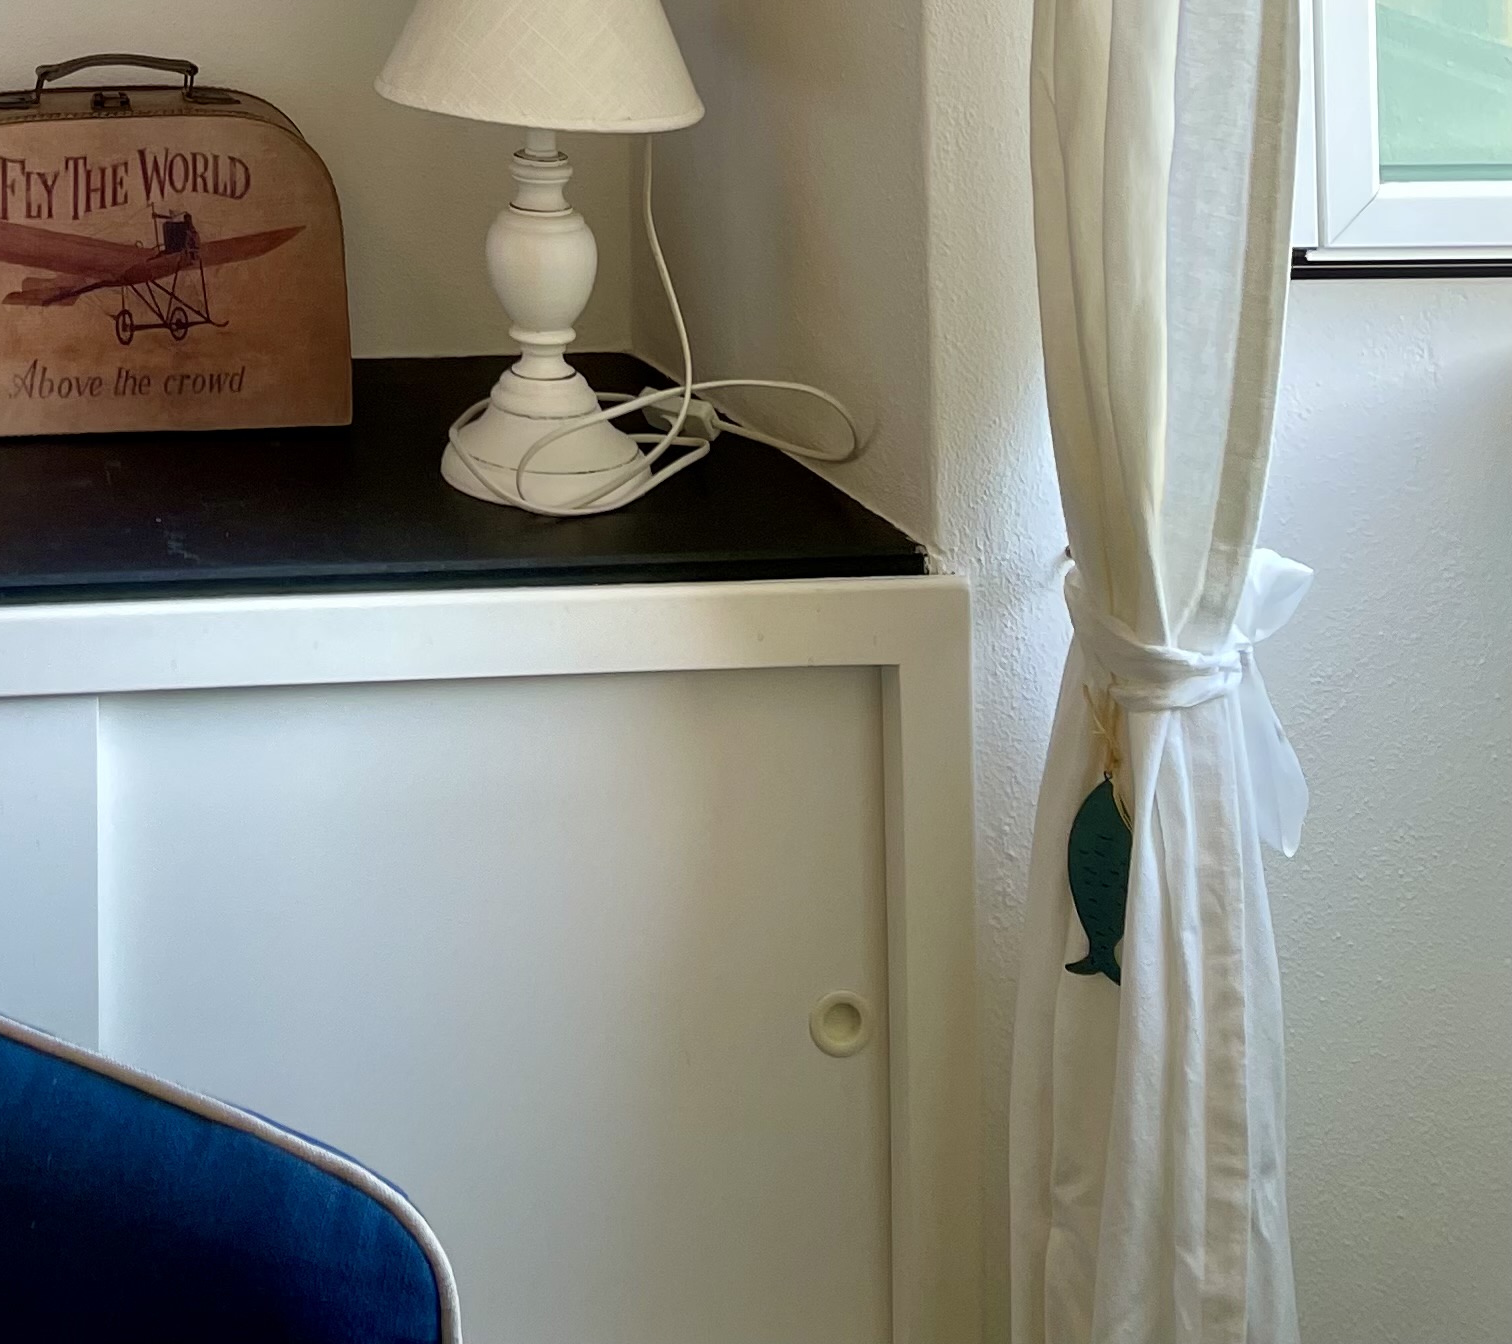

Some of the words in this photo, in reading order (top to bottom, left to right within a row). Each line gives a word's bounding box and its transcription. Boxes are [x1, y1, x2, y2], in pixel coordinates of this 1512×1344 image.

[9, 359, 103, 400] Above
[114, 367, 151, 396] the
[163, 365, 246, 395] crowd
